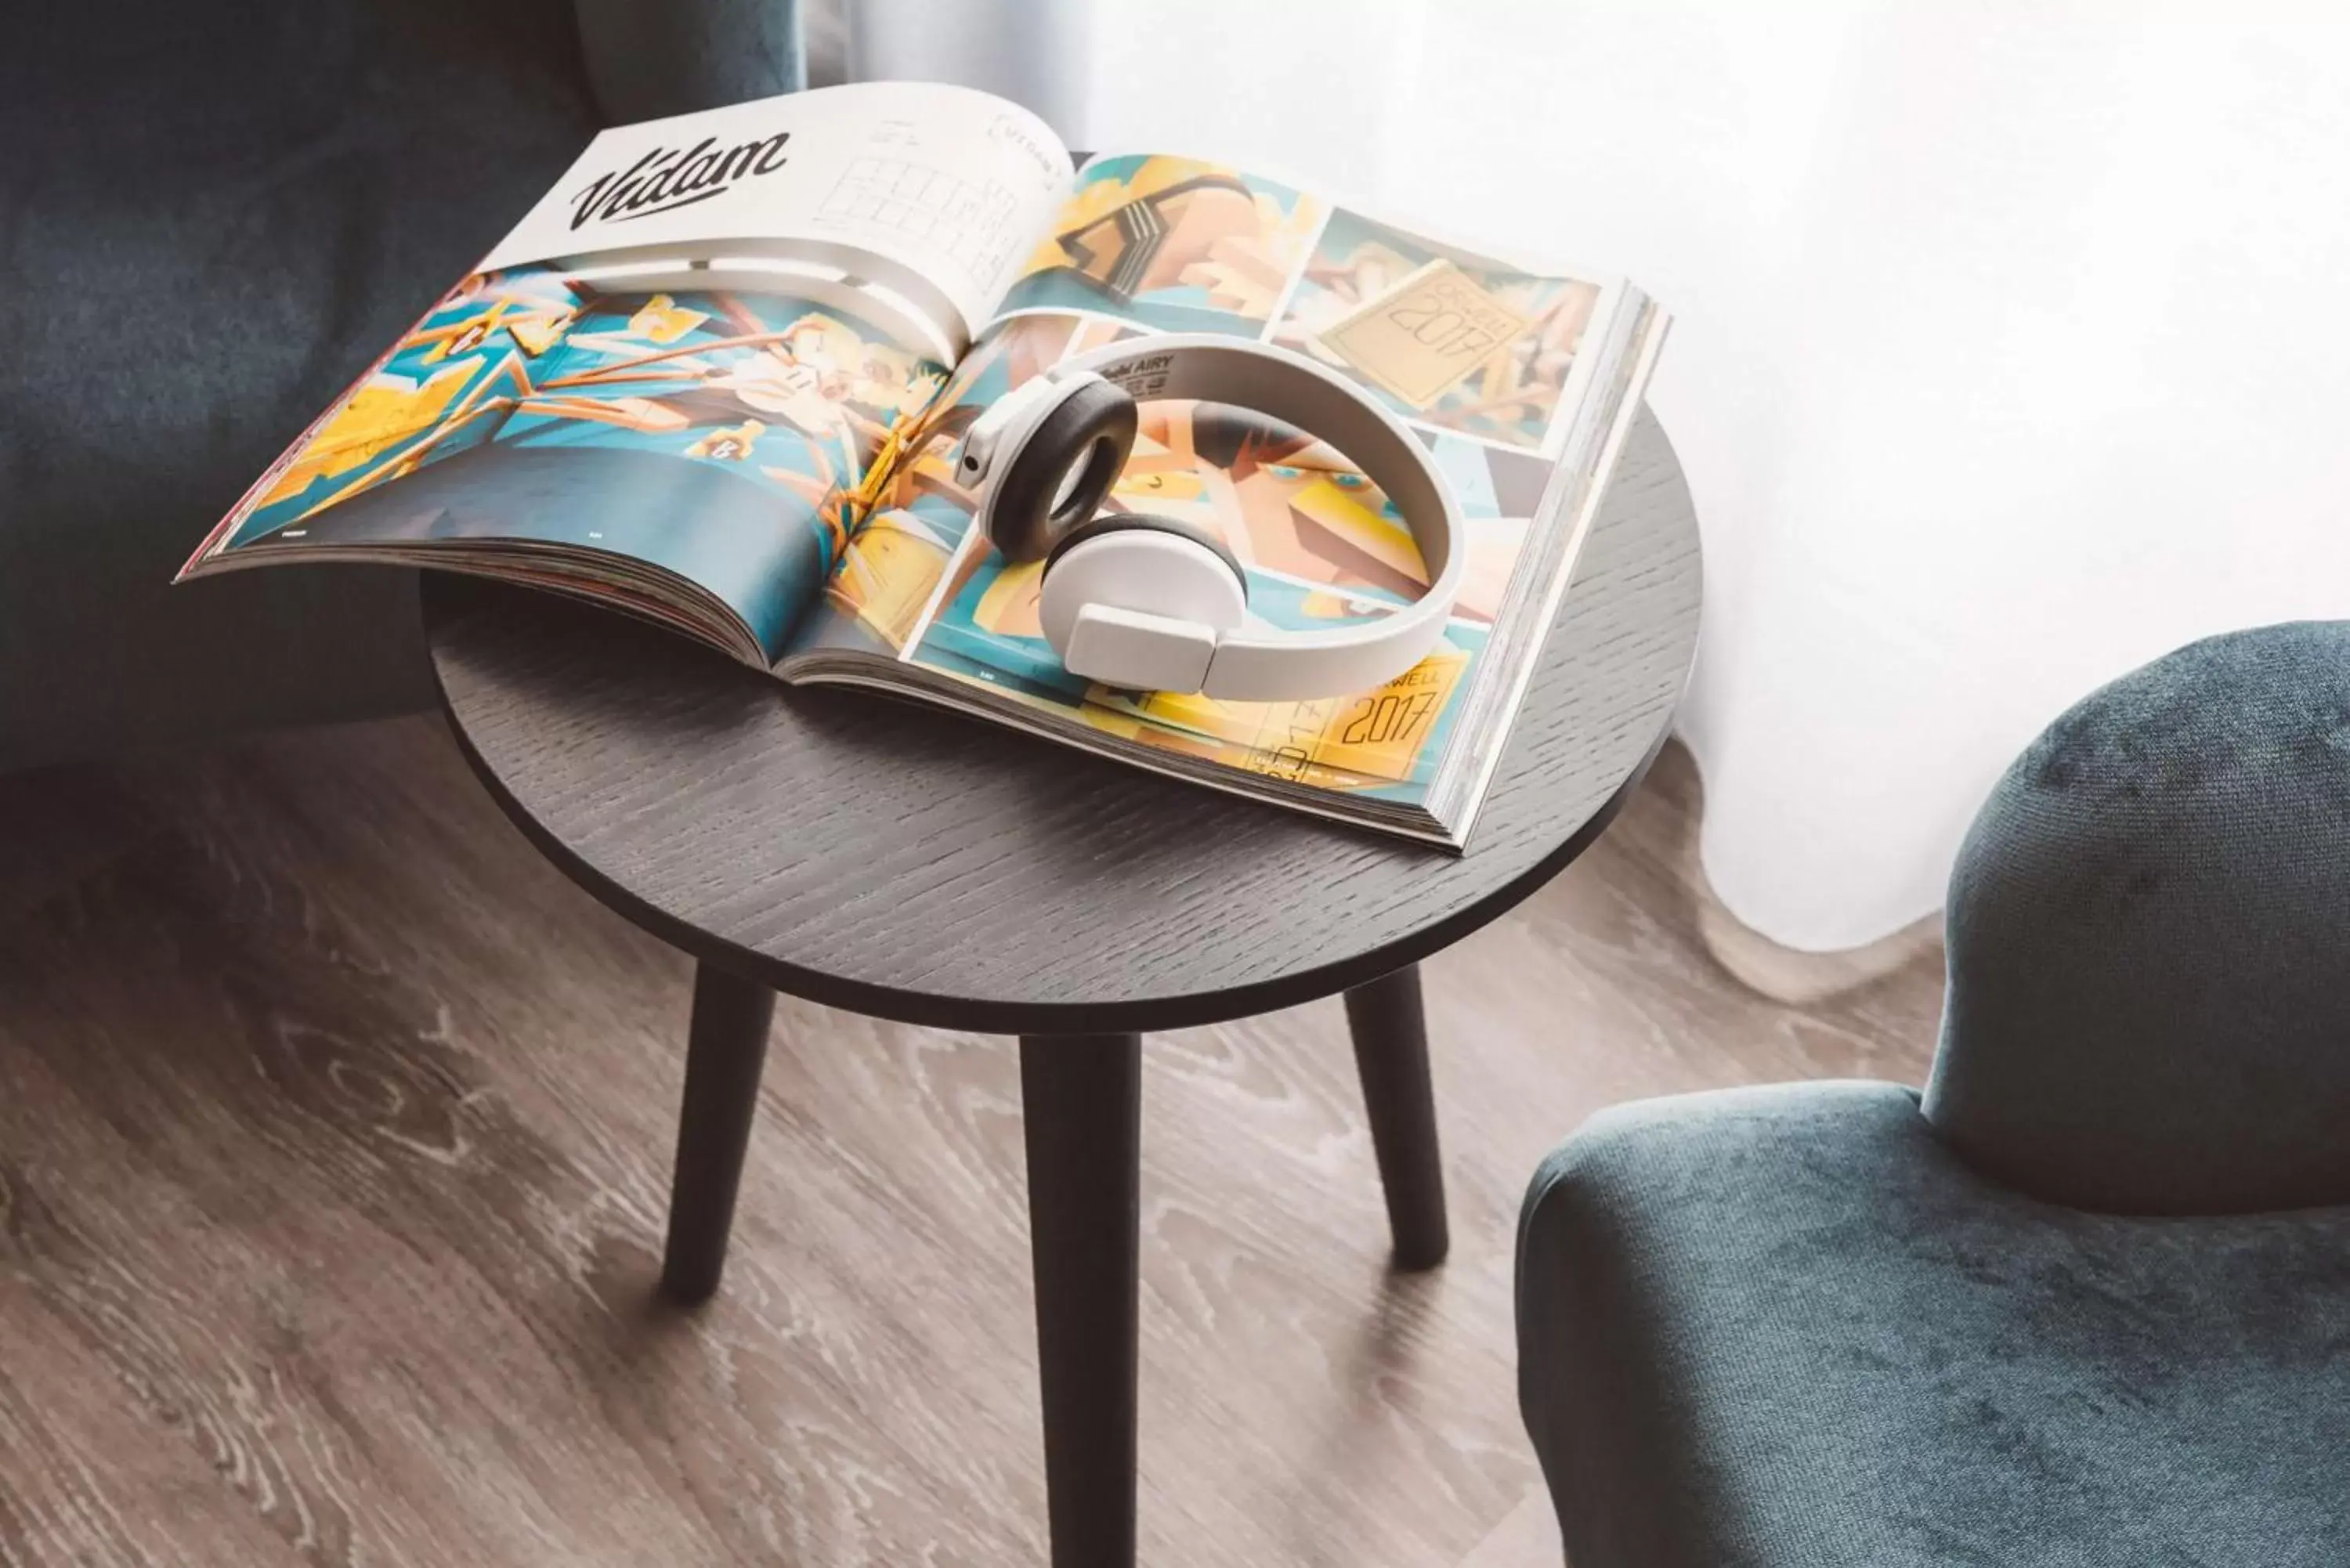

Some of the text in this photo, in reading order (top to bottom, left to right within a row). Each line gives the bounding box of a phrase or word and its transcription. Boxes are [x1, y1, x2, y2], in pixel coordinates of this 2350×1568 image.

[1387, 293, 1495, 356] 2017
[1133, 354, 1175, 374] AIRY
[1342, 692, 1437, 744] 2017
